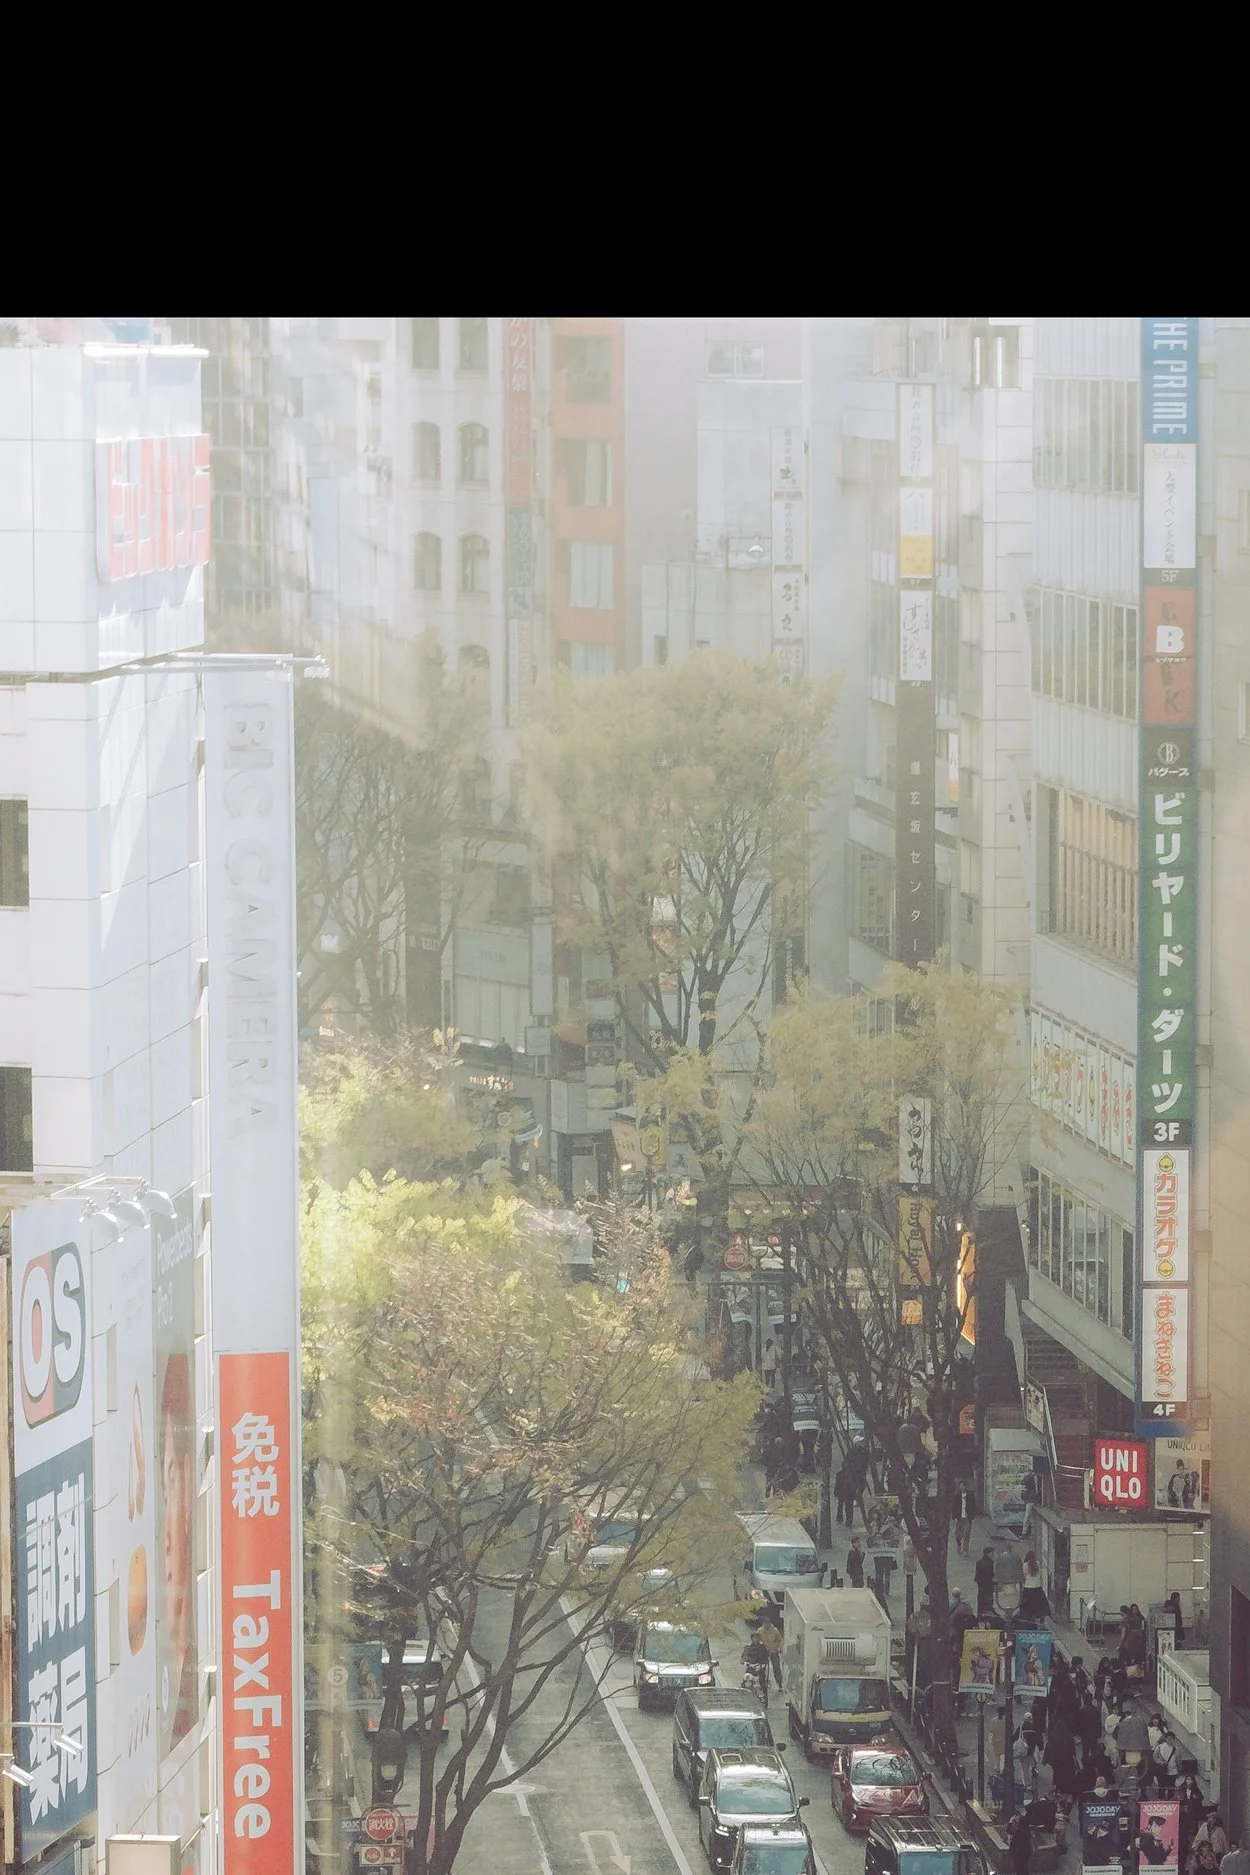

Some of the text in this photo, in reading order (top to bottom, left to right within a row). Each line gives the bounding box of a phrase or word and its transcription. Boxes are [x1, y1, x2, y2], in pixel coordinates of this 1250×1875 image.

[1152, 318, 1188, 350] HE
[1152, 359, 1188, 435] PRIME
[1160, 570, 1180, 584] 5F
[222, 703, 279, 1141] BIC CAMERA
[1153, 1122, 1180, 1141] 3F
[1154, 1172, 1178, 1261] カラオケ
[20, 1243, 87, 1430] OS
[1153, 1292, 1177, 1399] まねきねこ
[1153, 1403, 1176, 1416] 4F
[230, 1412, 280, 1518] 免税
[1100, 1474, 1142, 1501] QLO
[1101, 1447, 1139, 1473] UNI
[25, 1473, 89, 1656] 調剤
[27, 1646, 89, 1827] 薬局
[232, 1569, 282, 1840] TaxFree
